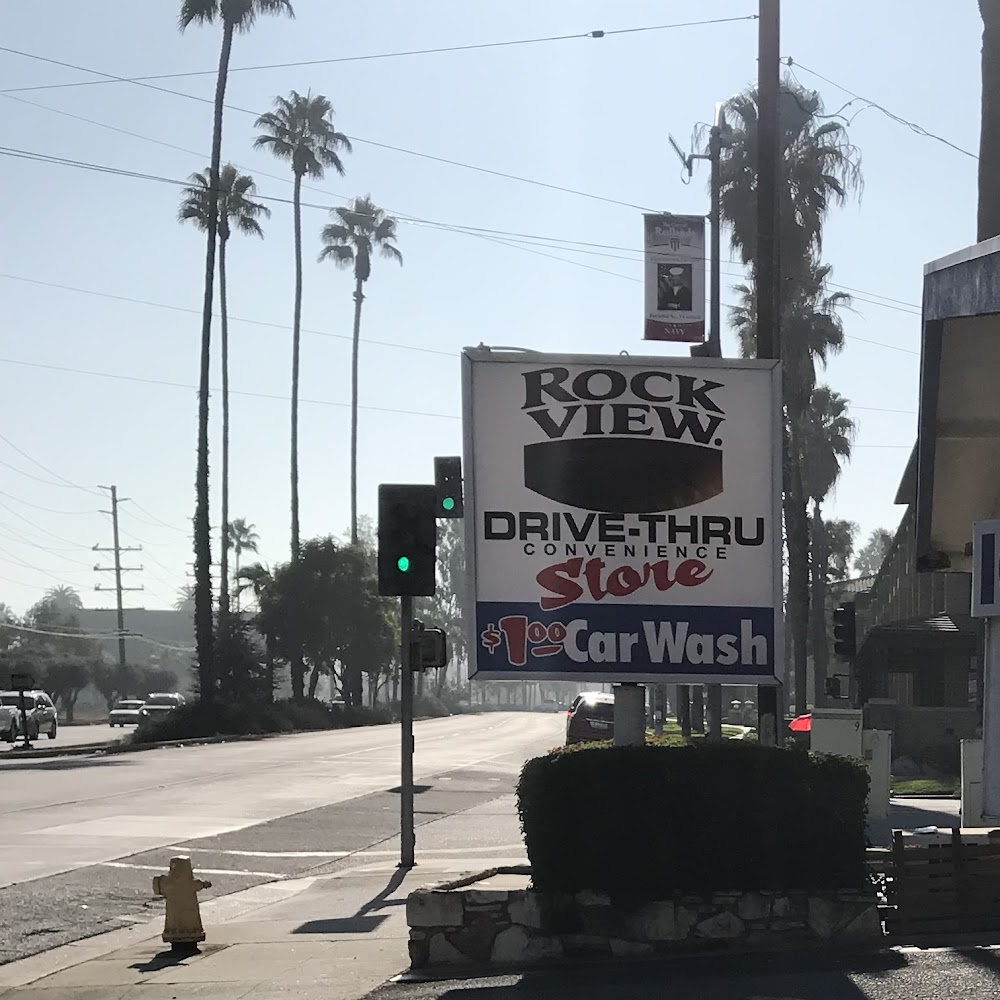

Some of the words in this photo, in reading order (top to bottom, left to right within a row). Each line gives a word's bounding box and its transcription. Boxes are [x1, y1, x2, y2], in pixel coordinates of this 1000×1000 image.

[520, 367, 725, 415] ROCK
[483, 511, 765, 546] DRIVE-THRU
[523, 543, 728, 560] CONVENIENCE
[535, 557, 714, 612] Store
[564, 619, 639, 664] Car
[642, 619, 768, 666] Wash
